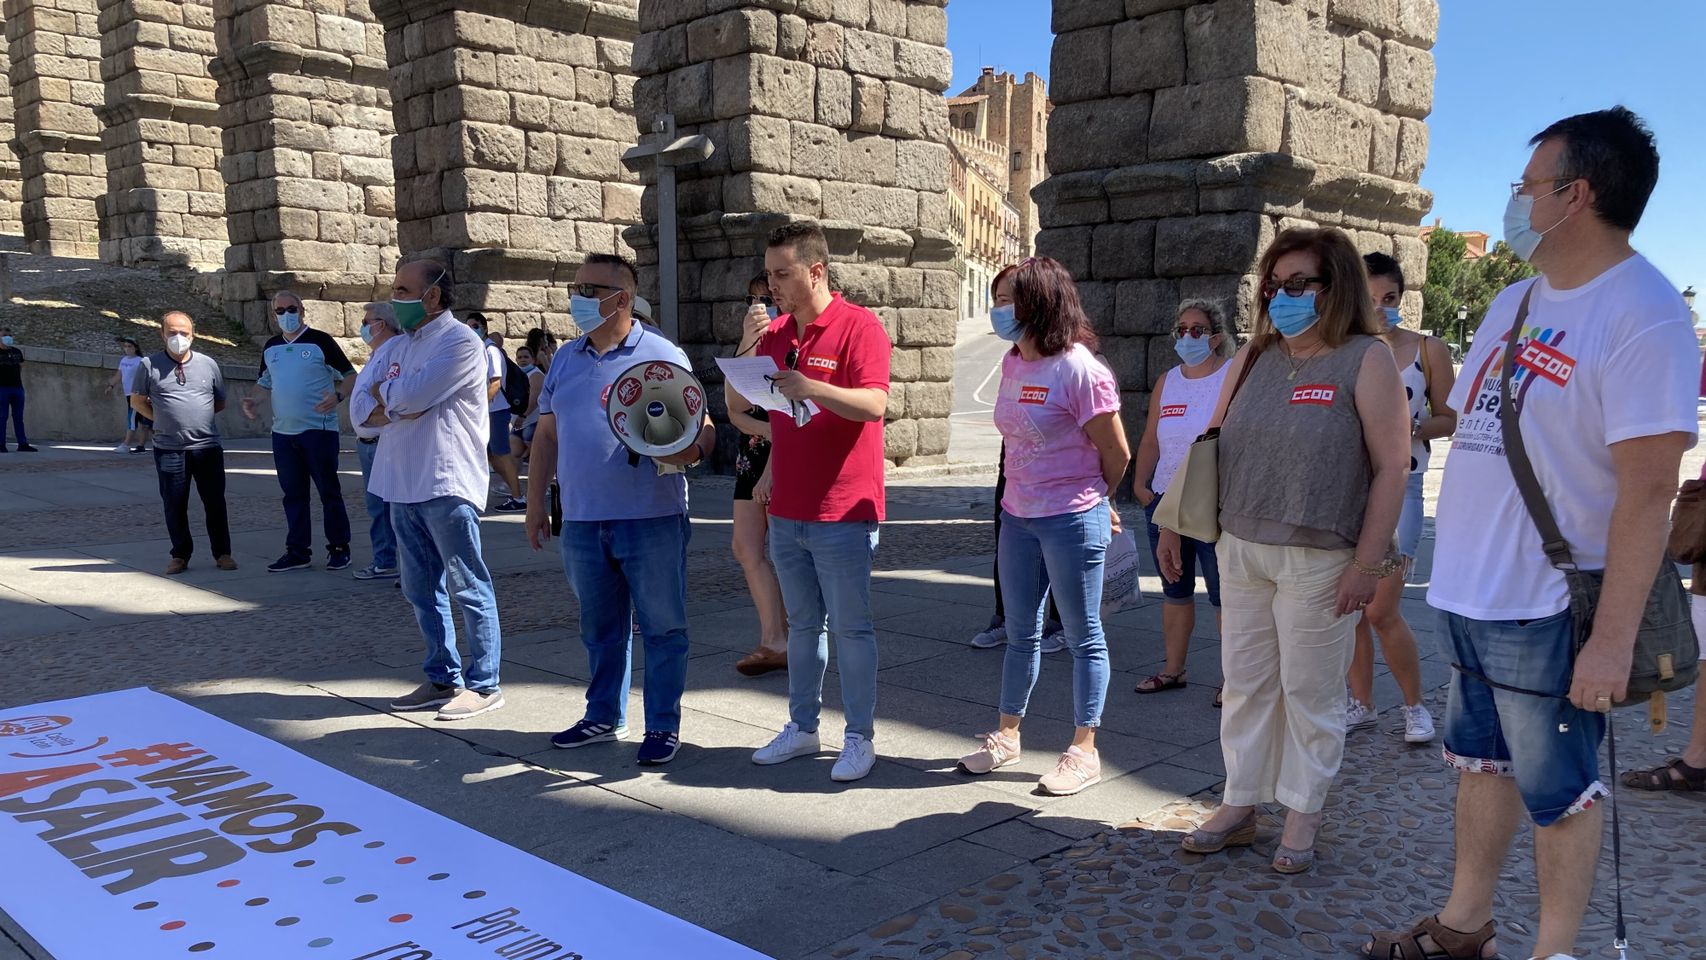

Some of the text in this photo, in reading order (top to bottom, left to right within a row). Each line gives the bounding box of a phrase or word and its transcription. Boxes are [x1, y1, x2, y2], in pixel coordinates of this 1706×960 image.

[807, 356, 838, 370] CCOO
[1521, 346, 1573, 381] CCOO
[1020, 390, 1047, 401] CCOO
[1291, 389, 1334, 401] CCOO
[98, 742, 362, 853] #VAMOS
[0, 779, 247, 896] SALIR
[451, 906, 531, 944] Por
